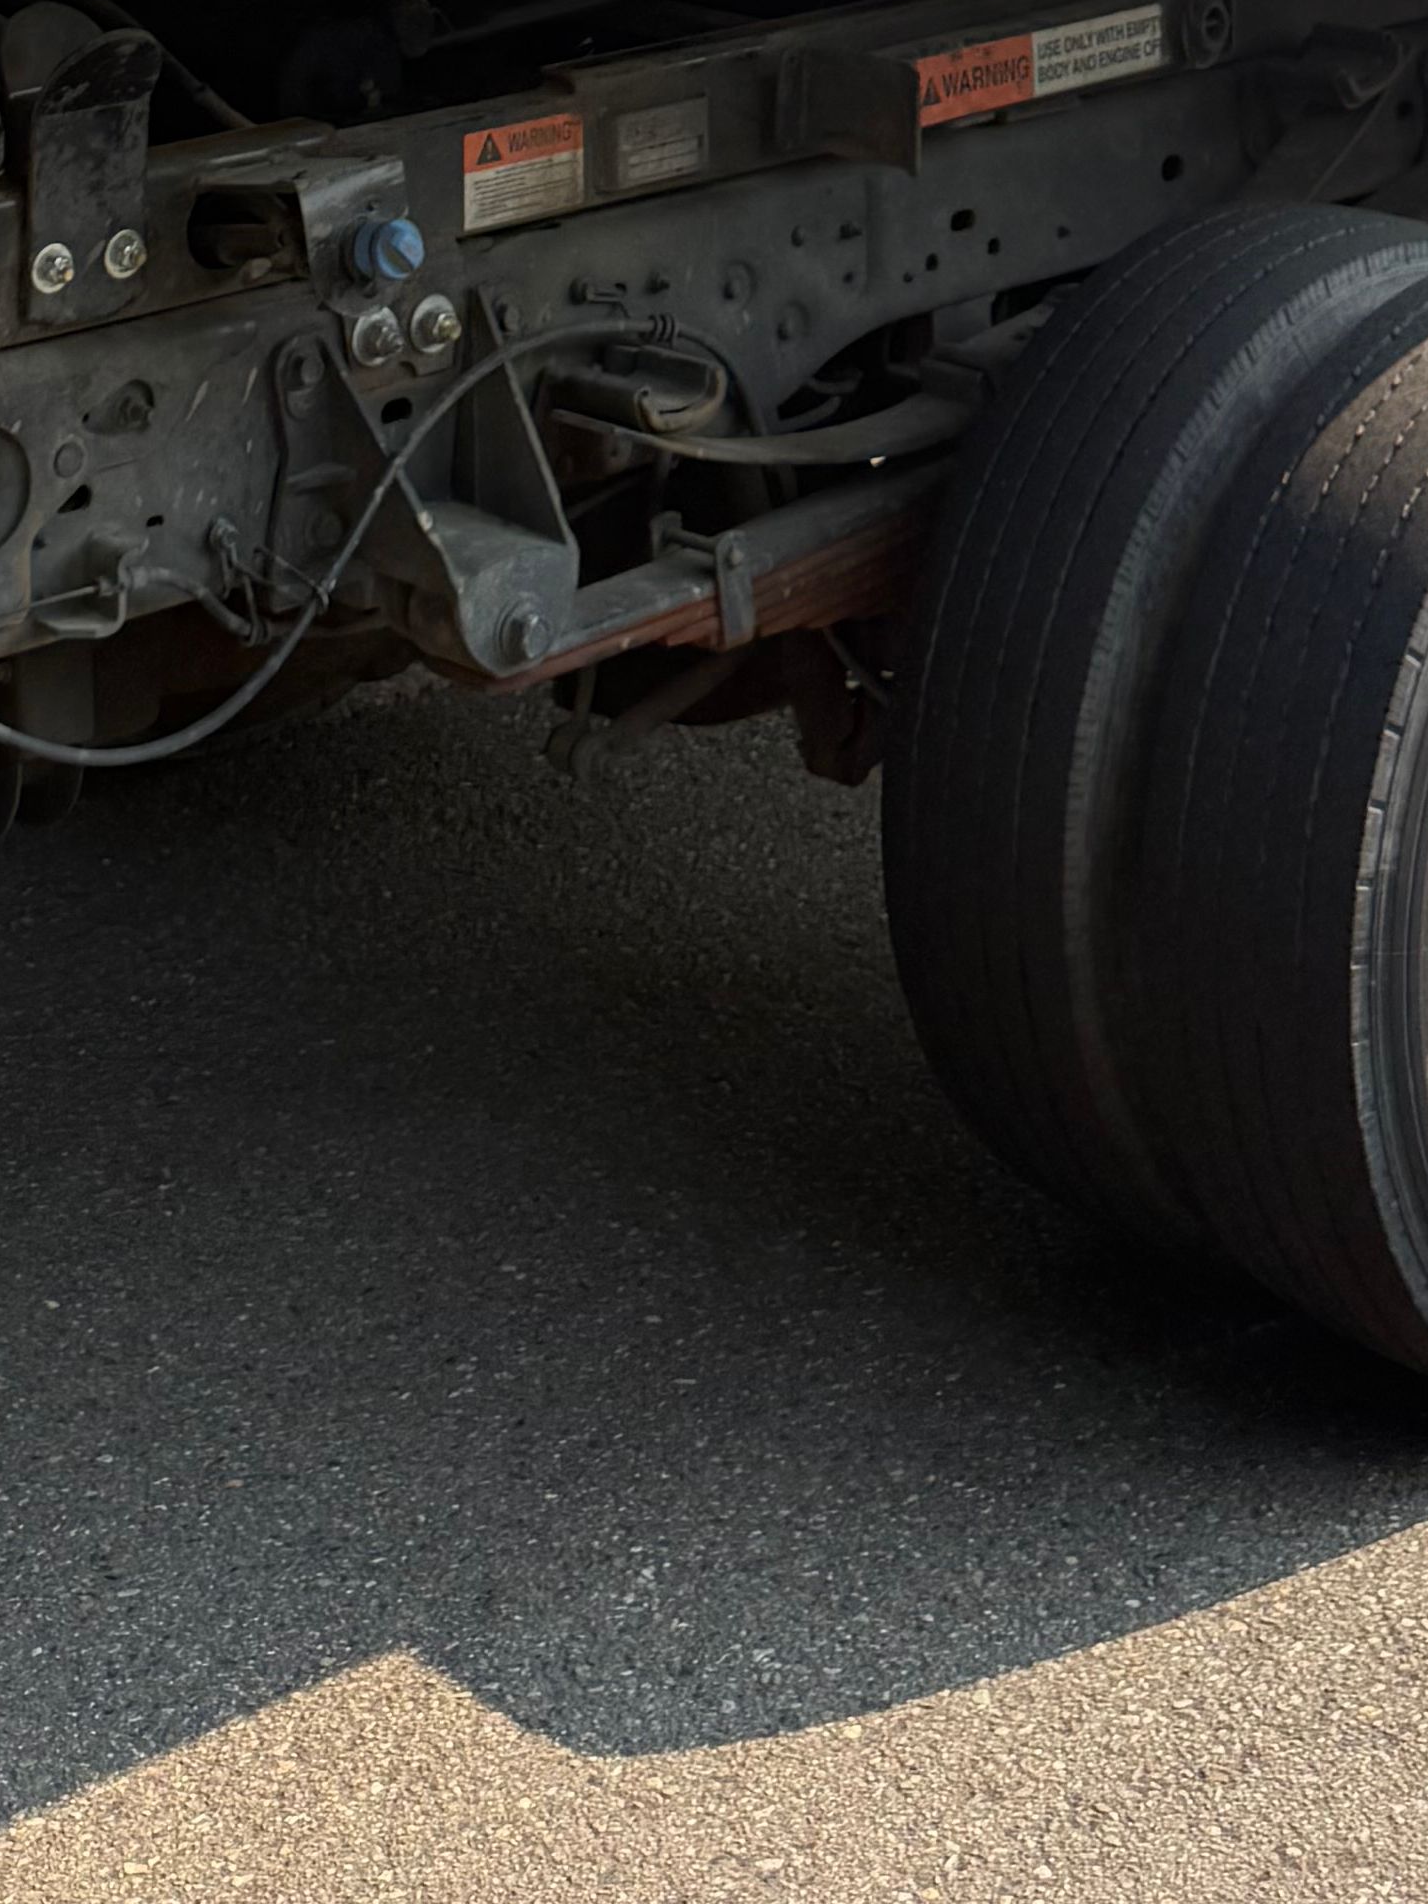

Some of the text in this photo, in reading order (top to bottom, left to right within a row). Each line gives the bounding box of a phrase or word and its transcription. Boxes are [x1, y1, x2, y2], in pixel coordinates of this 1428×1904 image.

[1037, 15, 1160, 60] USE ONLY WITH EMPT
[942, 55, 1030, 97] WARNING
[1037, 38, 1163, 83] BODY AND ENGINE OF
[509, 120, 572, 152] WARNING
